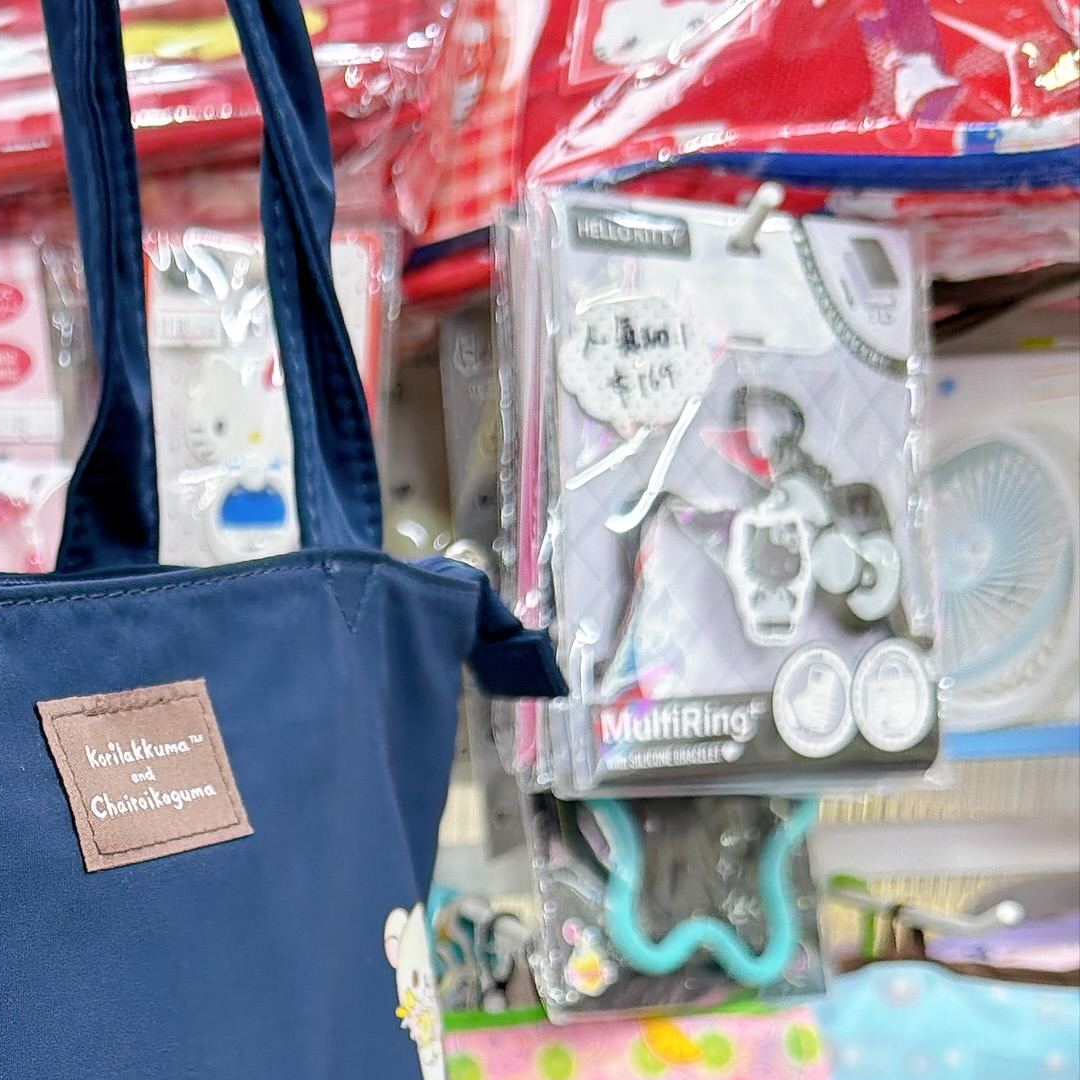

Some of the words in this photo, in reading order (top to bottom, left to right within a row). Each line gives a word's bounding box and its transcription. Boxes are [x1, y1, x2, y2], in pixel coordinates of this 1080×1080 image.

[629, 749, 671, 769] SILICONE
[131, 765, 156, 784] and
[90, 782, 217, 819] Chairoikoguma
